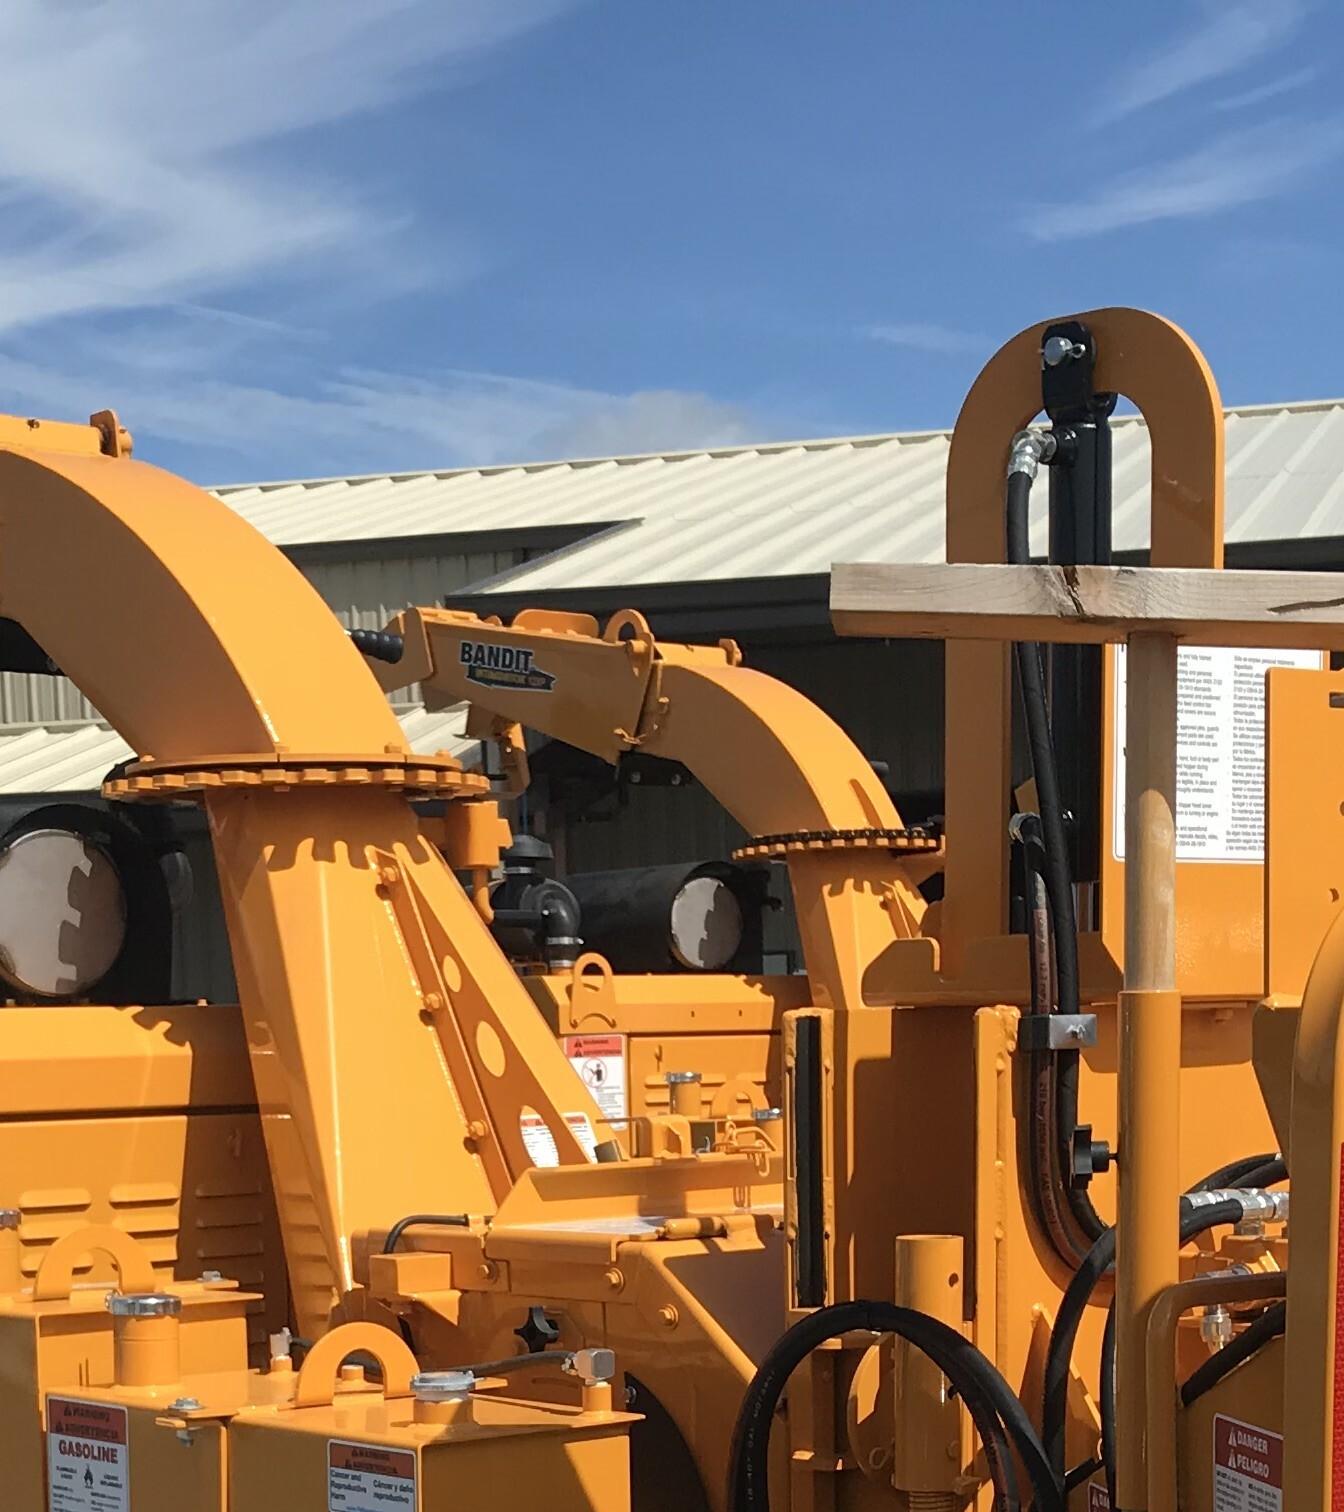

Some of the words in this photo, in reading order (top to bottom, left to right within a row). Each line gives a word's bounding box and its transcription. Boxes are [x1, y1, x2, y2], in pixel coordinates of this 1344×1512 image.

[461, 642, 533, 672] BANDIT
[58, 1439, 118, 1464] GASOLINE
[1237, 1430, 1268, 1455] DANGER
[1237, 1454, 1269, 1479] PELIGRO
